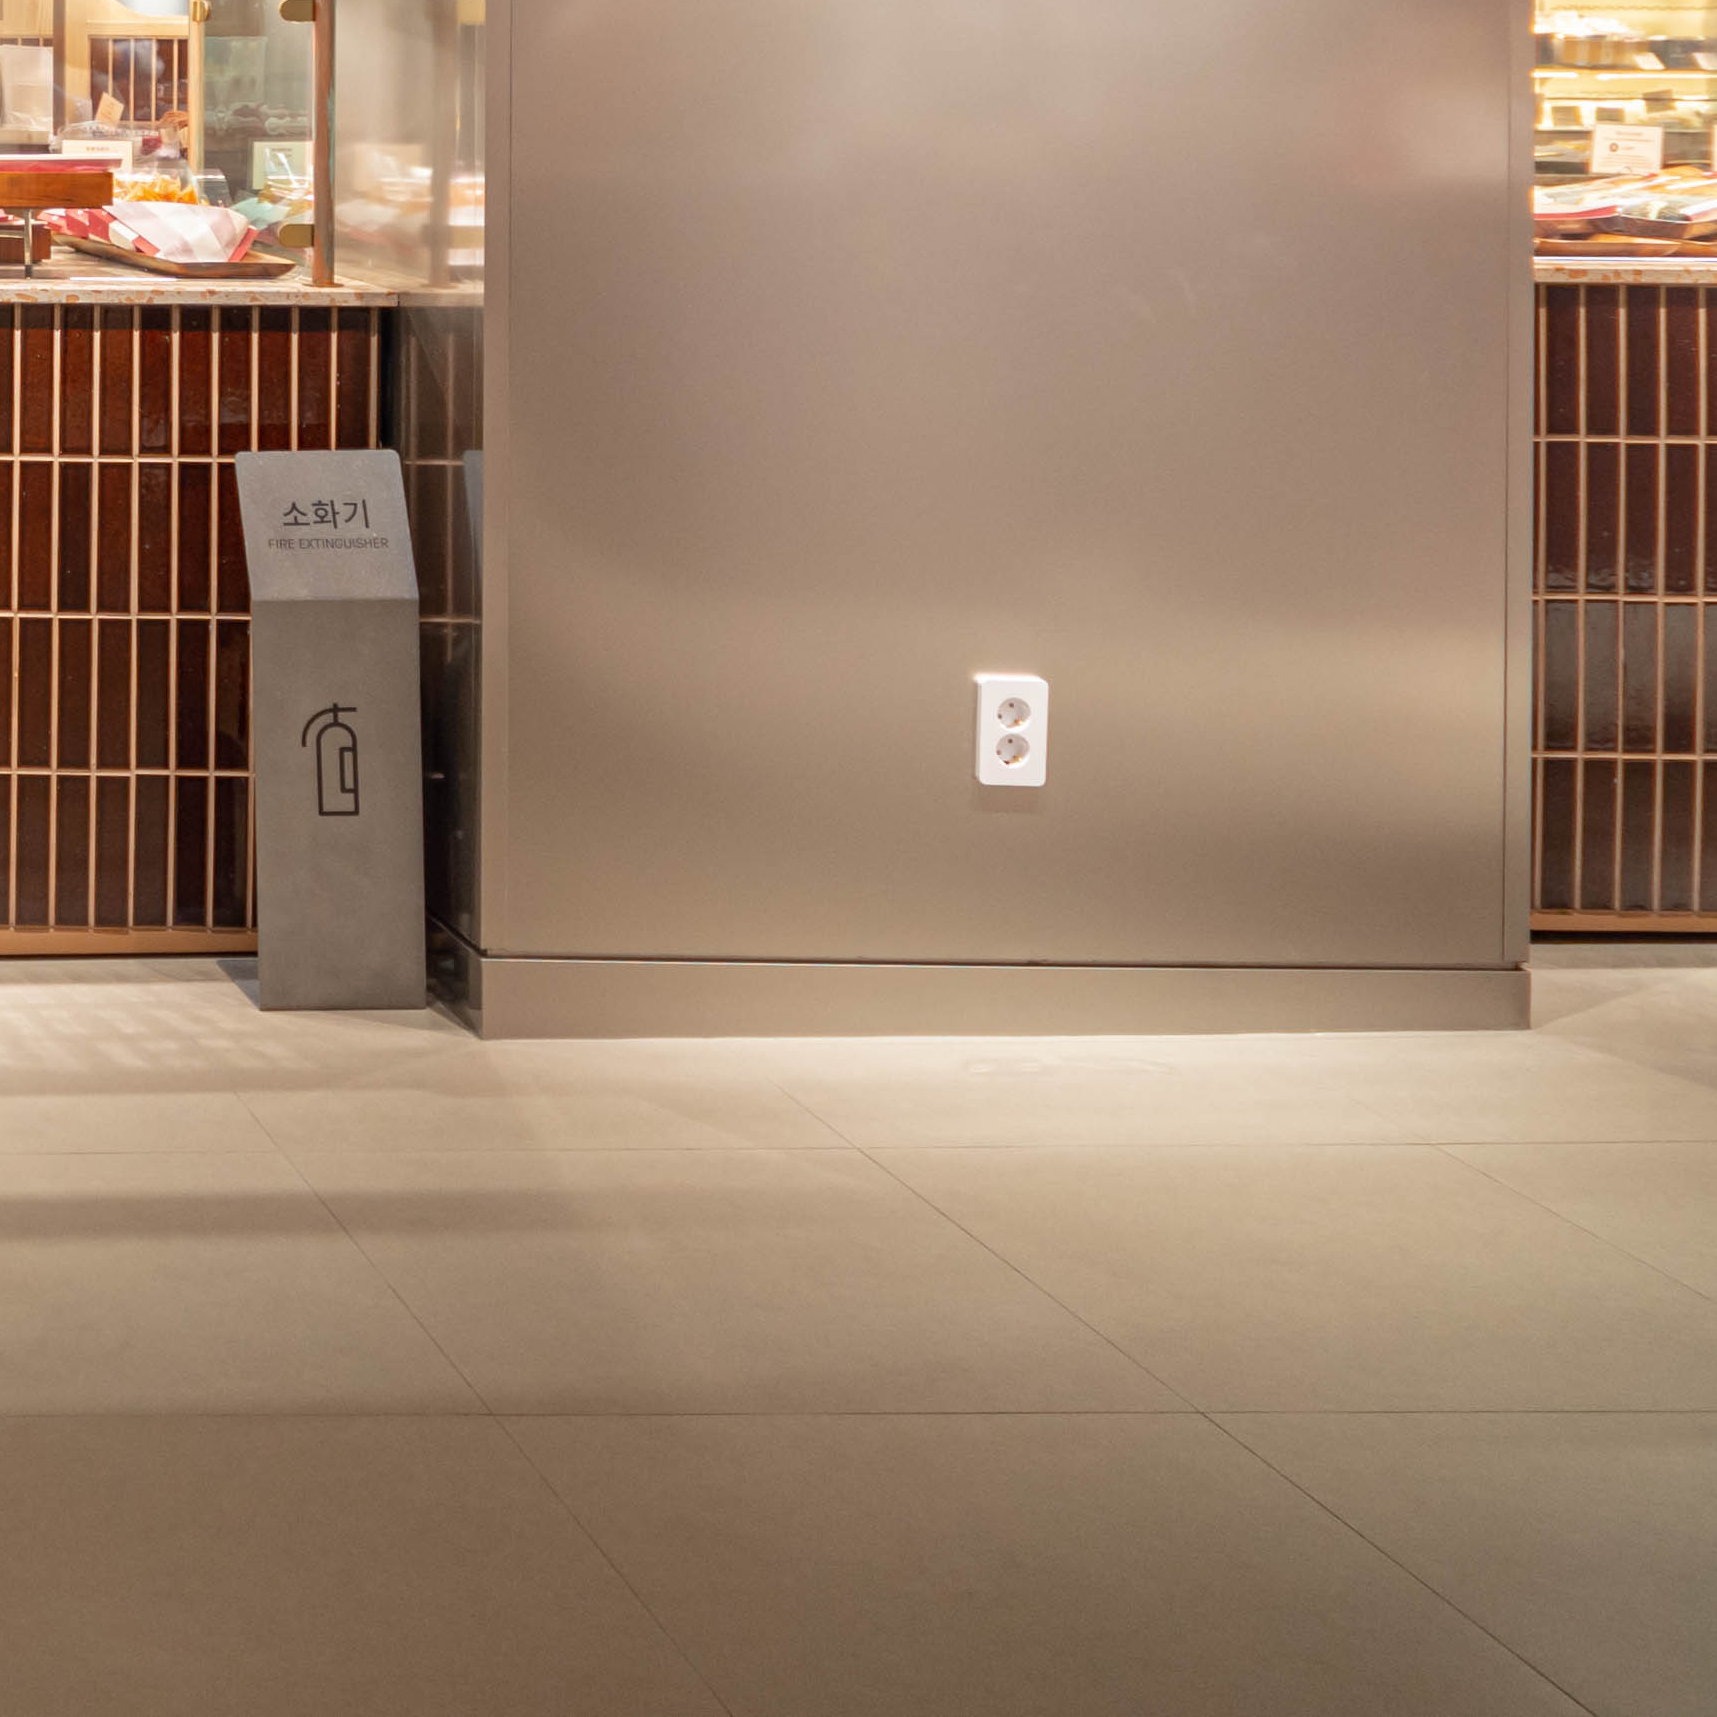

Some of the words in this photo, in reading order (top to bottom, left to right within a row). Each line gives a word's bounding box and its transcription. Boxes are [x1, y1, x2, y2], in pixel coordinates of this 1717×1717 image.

[282, 498, 370, 530] 소화기
[268, 538, 295, 550] FIRE
[298, 537, 390, 550] EXTINGUISHER
